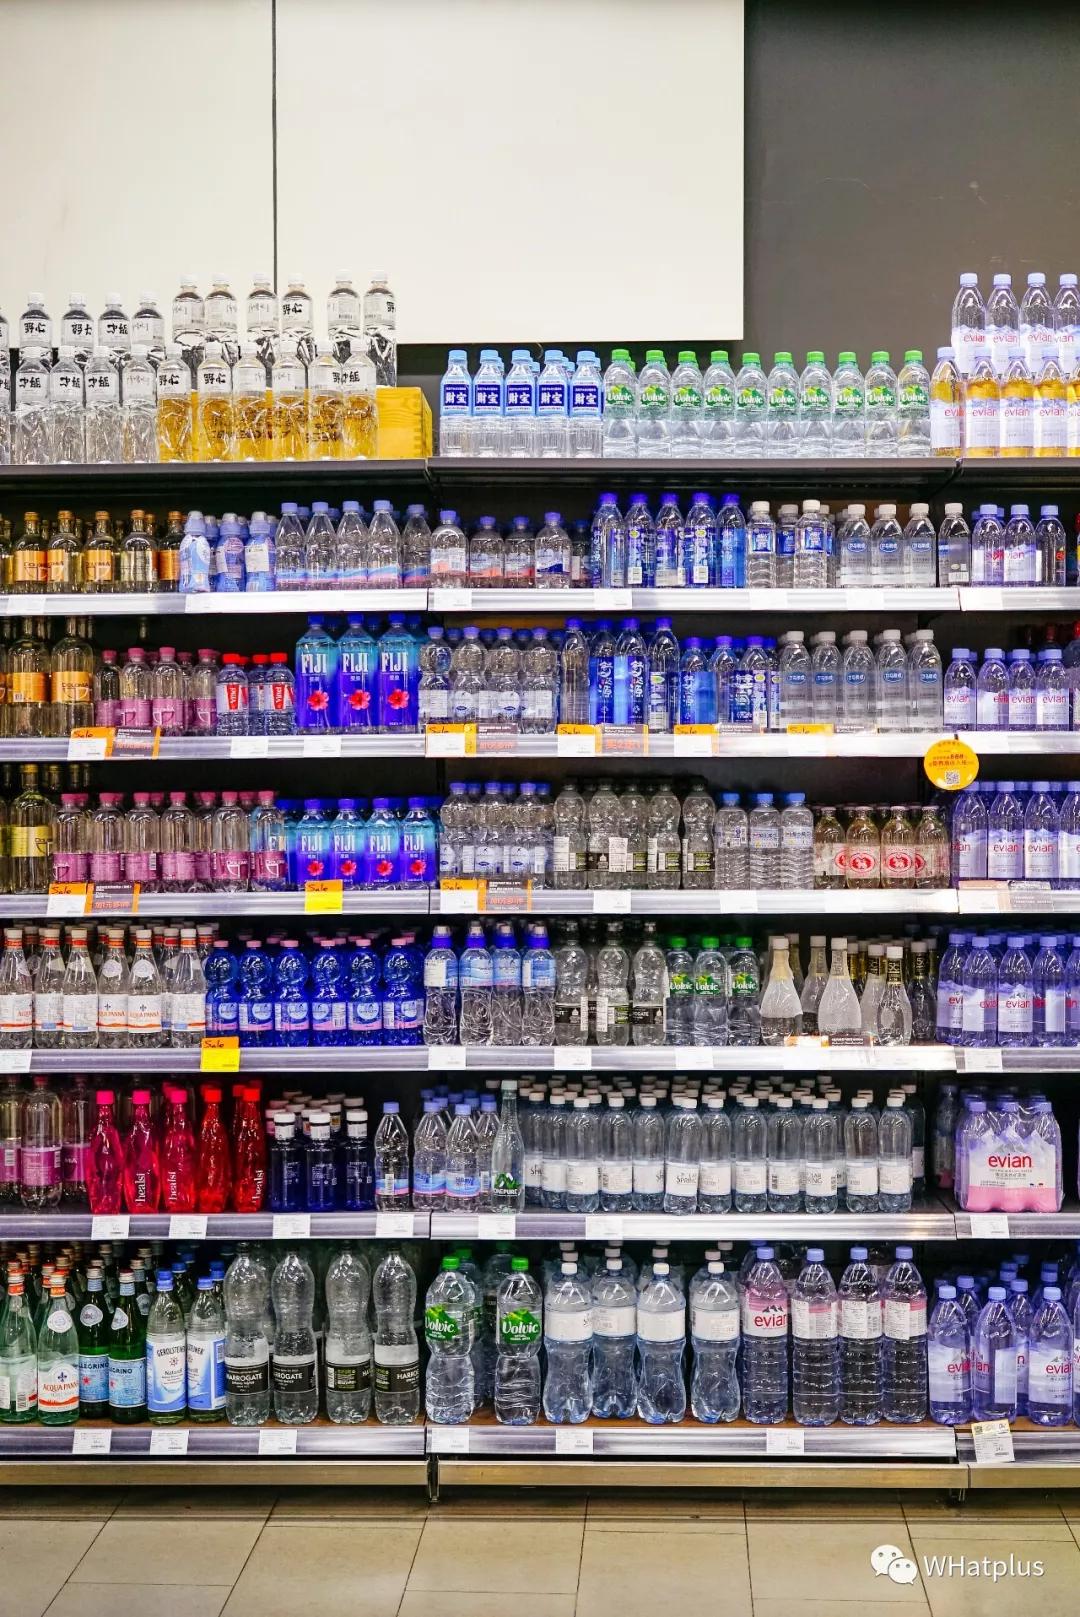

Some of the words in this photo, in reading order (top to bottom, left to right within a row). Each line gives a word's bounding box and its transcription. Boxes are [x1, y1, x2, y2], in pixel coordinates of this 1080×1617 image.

[1004, 408, 1030, 416] evian
[1040, 408, 1065, 416] evian
[302, 653, 327, 674] FIJI
[342, 652, 369, 672] FIJI
[382, 652, 408, 672] FIJI
[302, 835, 322, 851] FIJI
[334, 835, 356, 851] FIJI
[370, 835, 391, 851] FIJI
[404, 835, 424, 851] FIJI
[1028, 843, 1053, 852] evian
[308, 884, 328, 892] Sale
[670, 982, 692, 990] Volvic
[732, 982, 756, 990] Volvic
[204, 1040, 224, 1048] Sale
[988, 1154, 1032, 1168] evian
[425, 1317, 455, 1333] Volvic
[502, 1320, 538, 1334] Volvic
[43, 1382, 63, 1392] ACQUA
